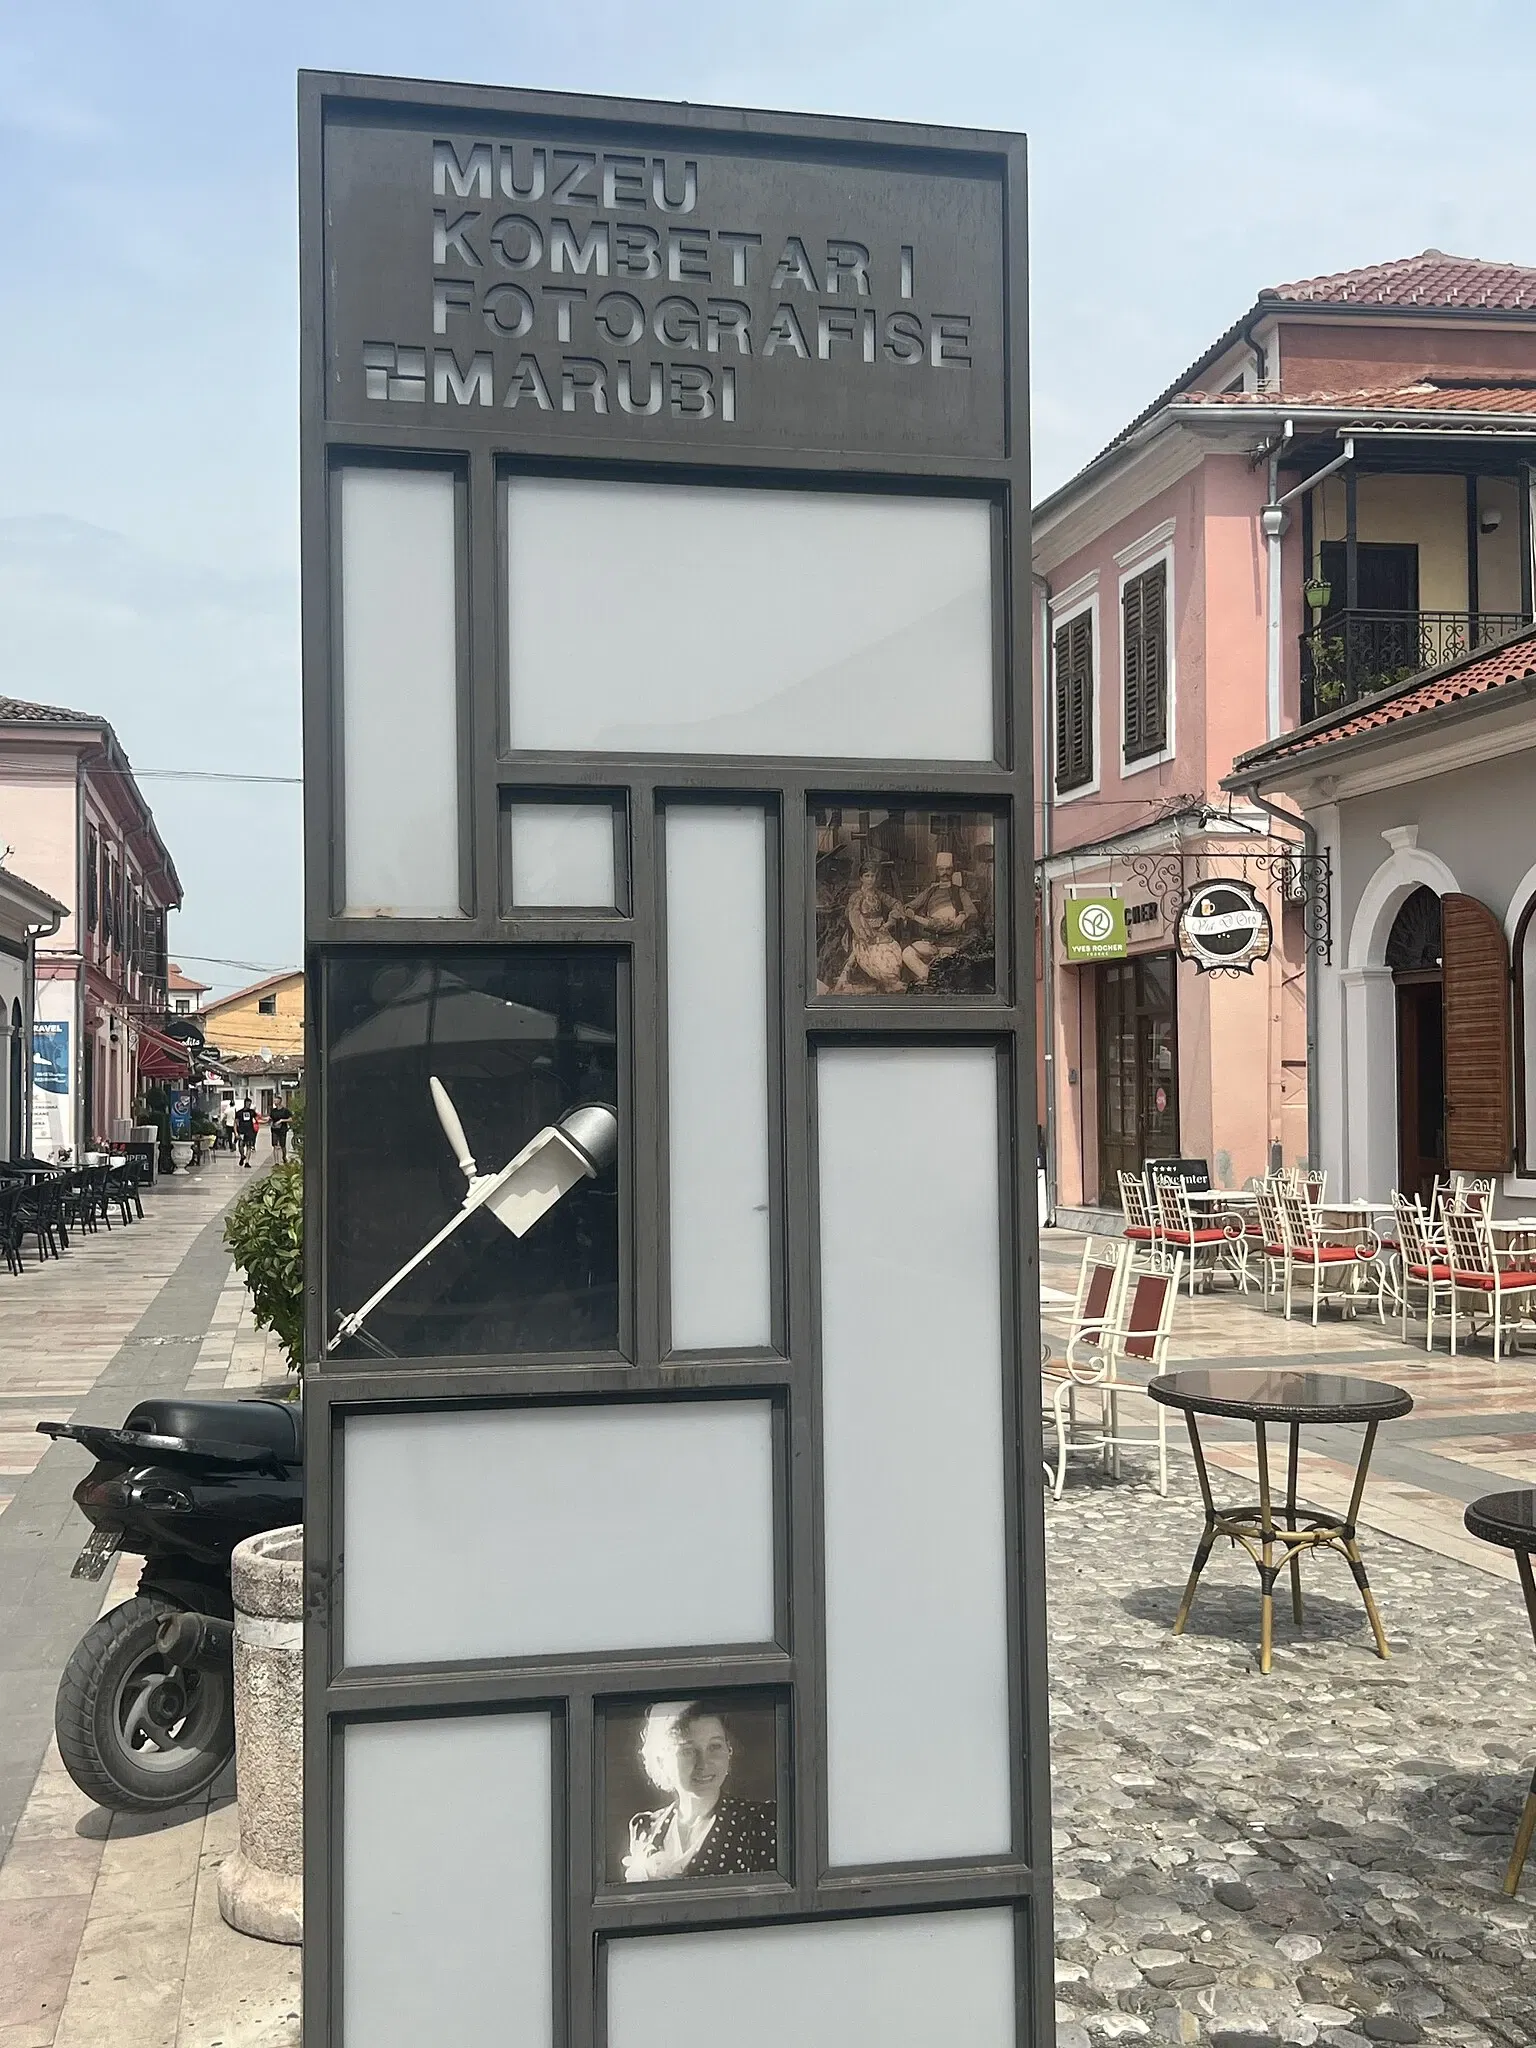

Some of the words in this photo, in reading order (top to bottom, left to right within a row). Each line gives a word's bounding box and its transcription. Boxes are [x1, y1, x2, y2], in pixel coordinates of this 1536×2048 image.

[433, 139, 698, 214] MUZEU
[433, 208, 872, 296] KOMBETAR
[901, 245, 914, 299] I
[433, 277, 972, 369] FOTOGRAFISE
[433, 347, 736, 422] MARUBI
[1071, 945, 1091, 953] YVES
[1092, 944, 1123, 952] ROCHER
[1124, 902, 1158, 926] CHER
[33, 1024, 63, 1033] RAVEL
